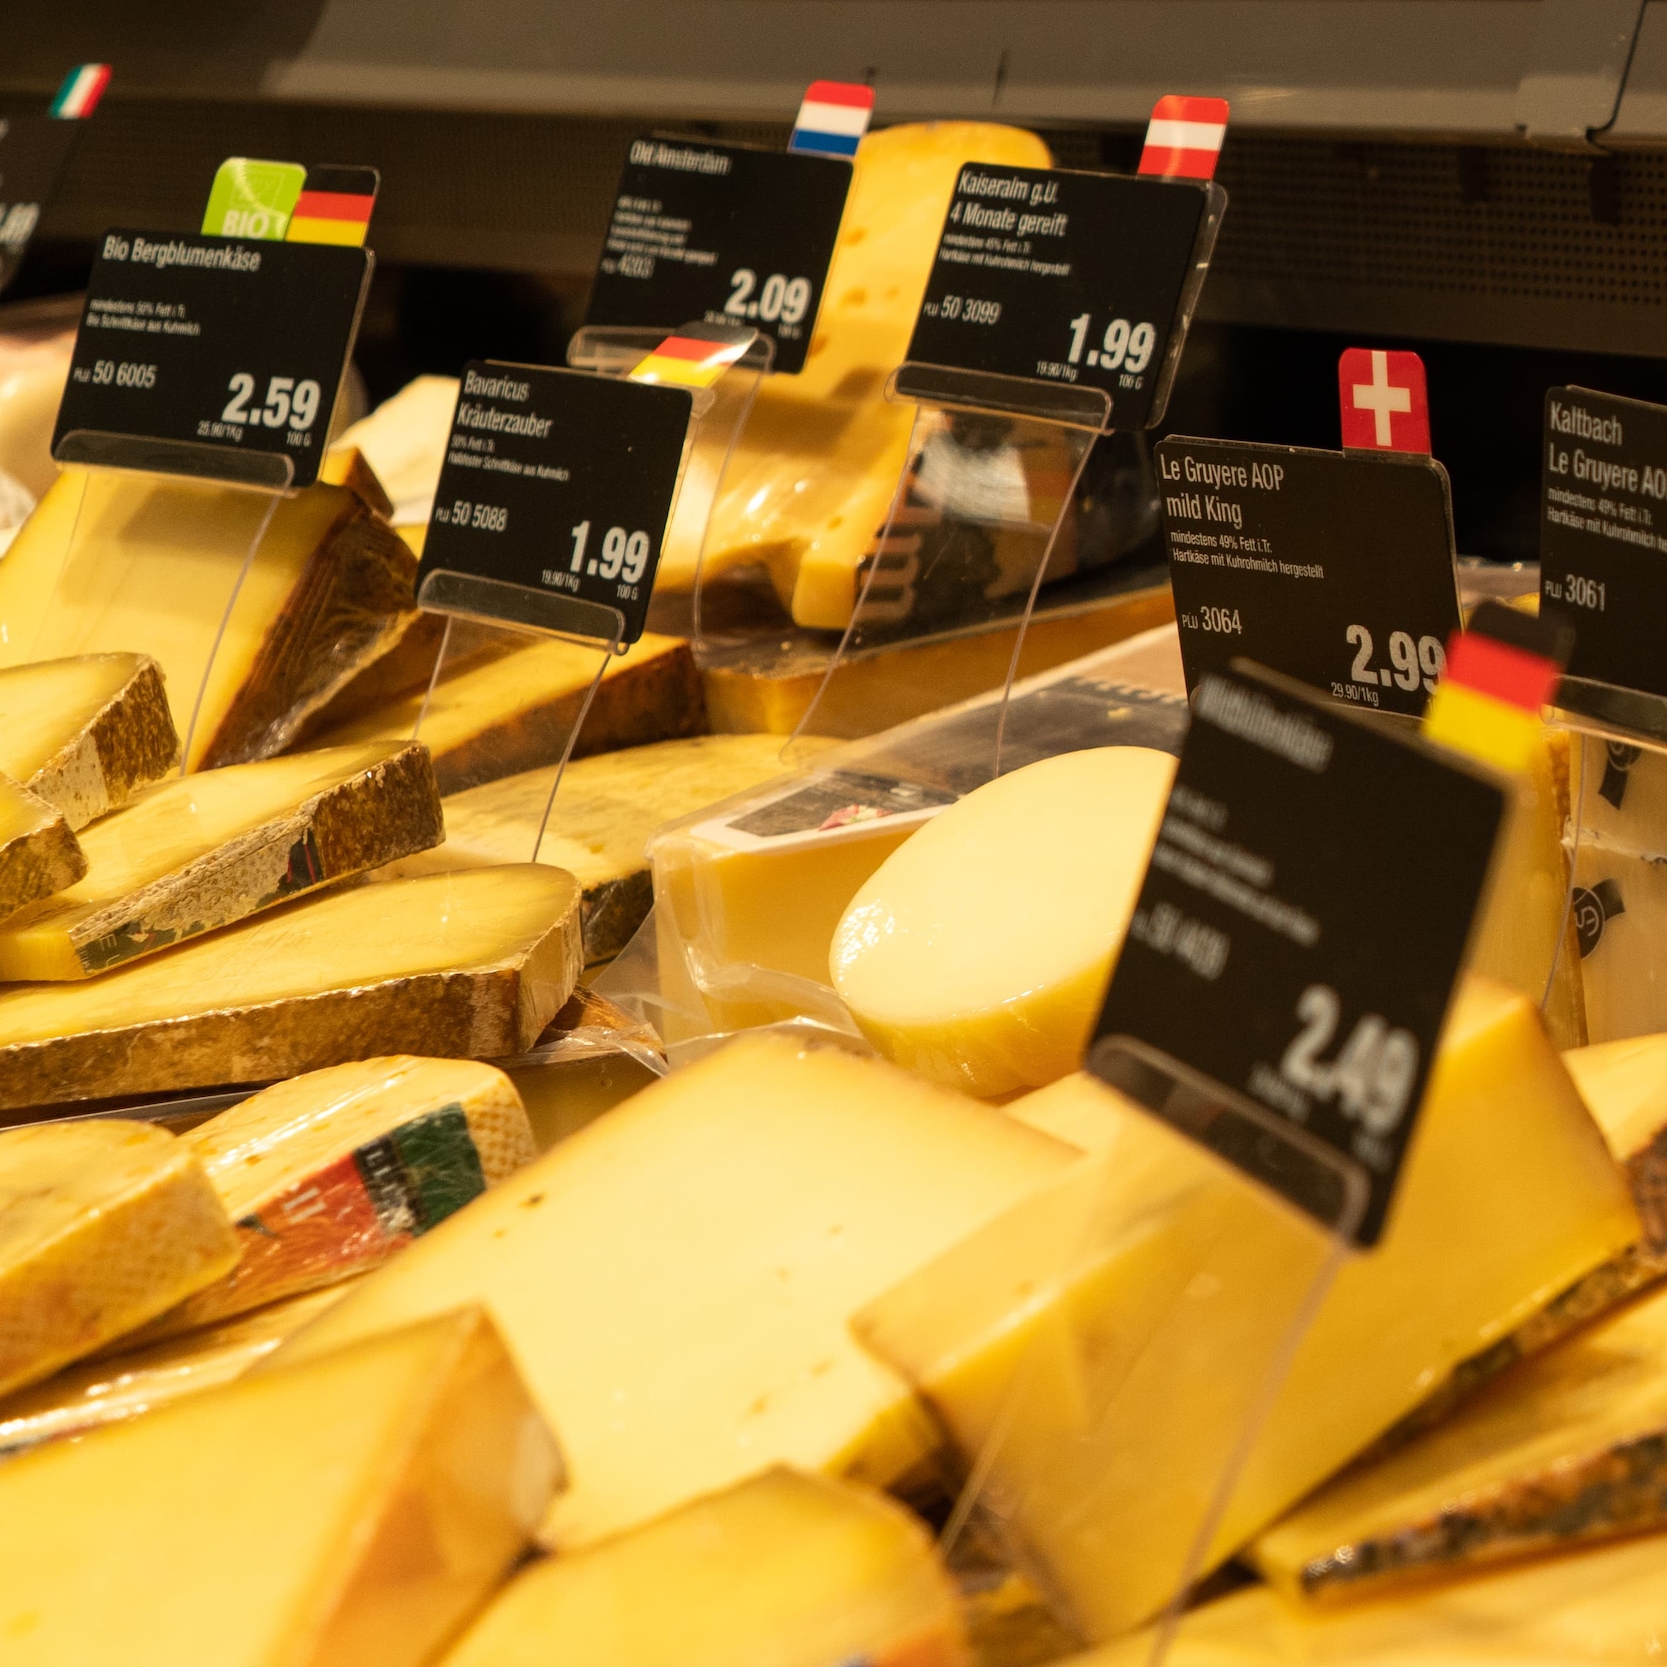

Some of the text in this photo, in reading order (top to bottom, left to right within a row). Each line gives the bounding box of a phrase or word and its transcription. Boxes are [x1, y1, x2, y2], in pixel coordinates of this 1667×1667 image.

[958, 170, 1060, 206] Kaiseralm g.U.
[221, 210, 269, 239] BIO
[951, 201, 1068, 237] 4 Monate gereift
[103, 235, 261, 272] Bio Bergblumenkäse
[724, 268, 812, 324] 2.09
[923, 295, 1002, 326] PLU 50 3099
[1068, 313, 1156, 374] 1.99
[92, 360, 115, 384] 50
[116, 364, 158, 388] 6005
[464, 369, 531, 401] Bavaricus
[221, 372, 321, 431] 2.59
[457, 401, 553, 439] Kräuterzauber
[1550, 401, 1623, 446] Kaltbach
[1160, 453, 1284, 492] Le Gruyere AOP
[1549, 443, 1568, 473] Le
[1573, 449, 1638, 493] Gruyere
[435, 506, 450, 522] PLU
[452, 500, 471, 526] 50
[1166, 493, 1242, 530] mild King
[1548, 487, 1596, 511] mindestens
[1618, 502, 1636, 520] Fett
[1548, 507, 1585, 532] Hartkäse
[1586, 516, 1600, 533] mit
[570, 520, 650, 584] 1.99
[1171, 531, 1218, 548] mindestens
[1219, 535, 1238, 550] 49%
[1240, 537, 1256, 552] Fett
[1173, 548, 1324, 579] Hartkäse mit Kuhrohmilch hergestellt
[616, 584, 631, 600] 100
[1545, 574, 1606, 611] PLU 3061
[1182, 606, 1242, 634] PLU 3064
[1346, 624, 1448, 695] 2.99
[1331, 682, 1379, 707] 29.90/1kg
[1281, 985, 1420, 1131] 2.49
